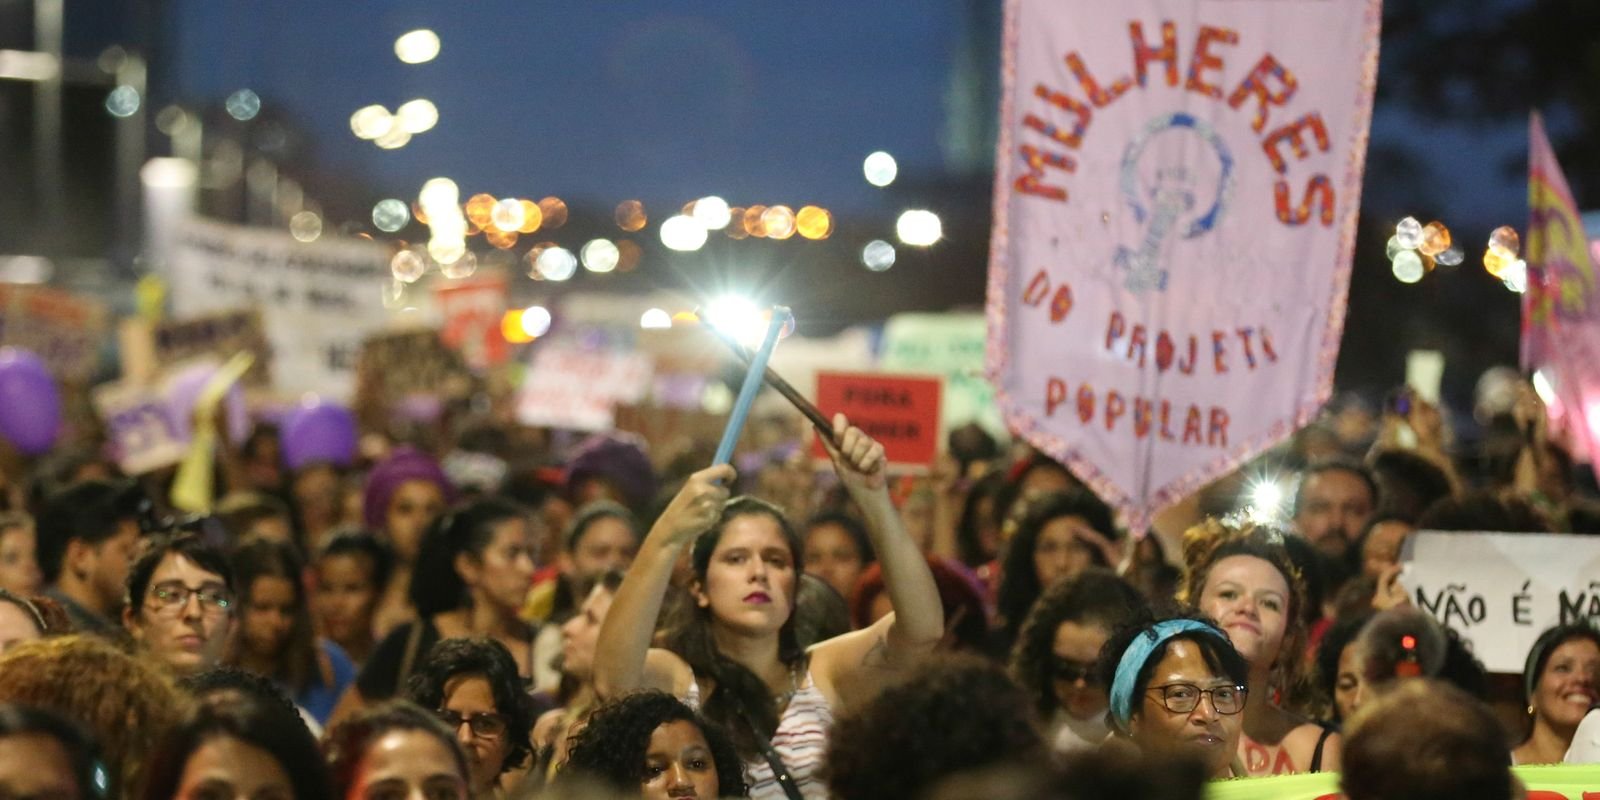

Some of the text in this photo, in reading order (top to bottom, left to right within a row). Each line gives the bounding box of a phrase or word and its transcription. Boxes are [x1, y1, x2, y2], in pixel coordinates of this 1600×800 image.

[1013, 19, 1336, 227] MULHERES
[1023, 269, 1073, 324] DO
[1045, 376, 1231, 447] POPULAR
[1416, 584, 1487, 627] NÃO
[1512, 579, 1534, 625] É
